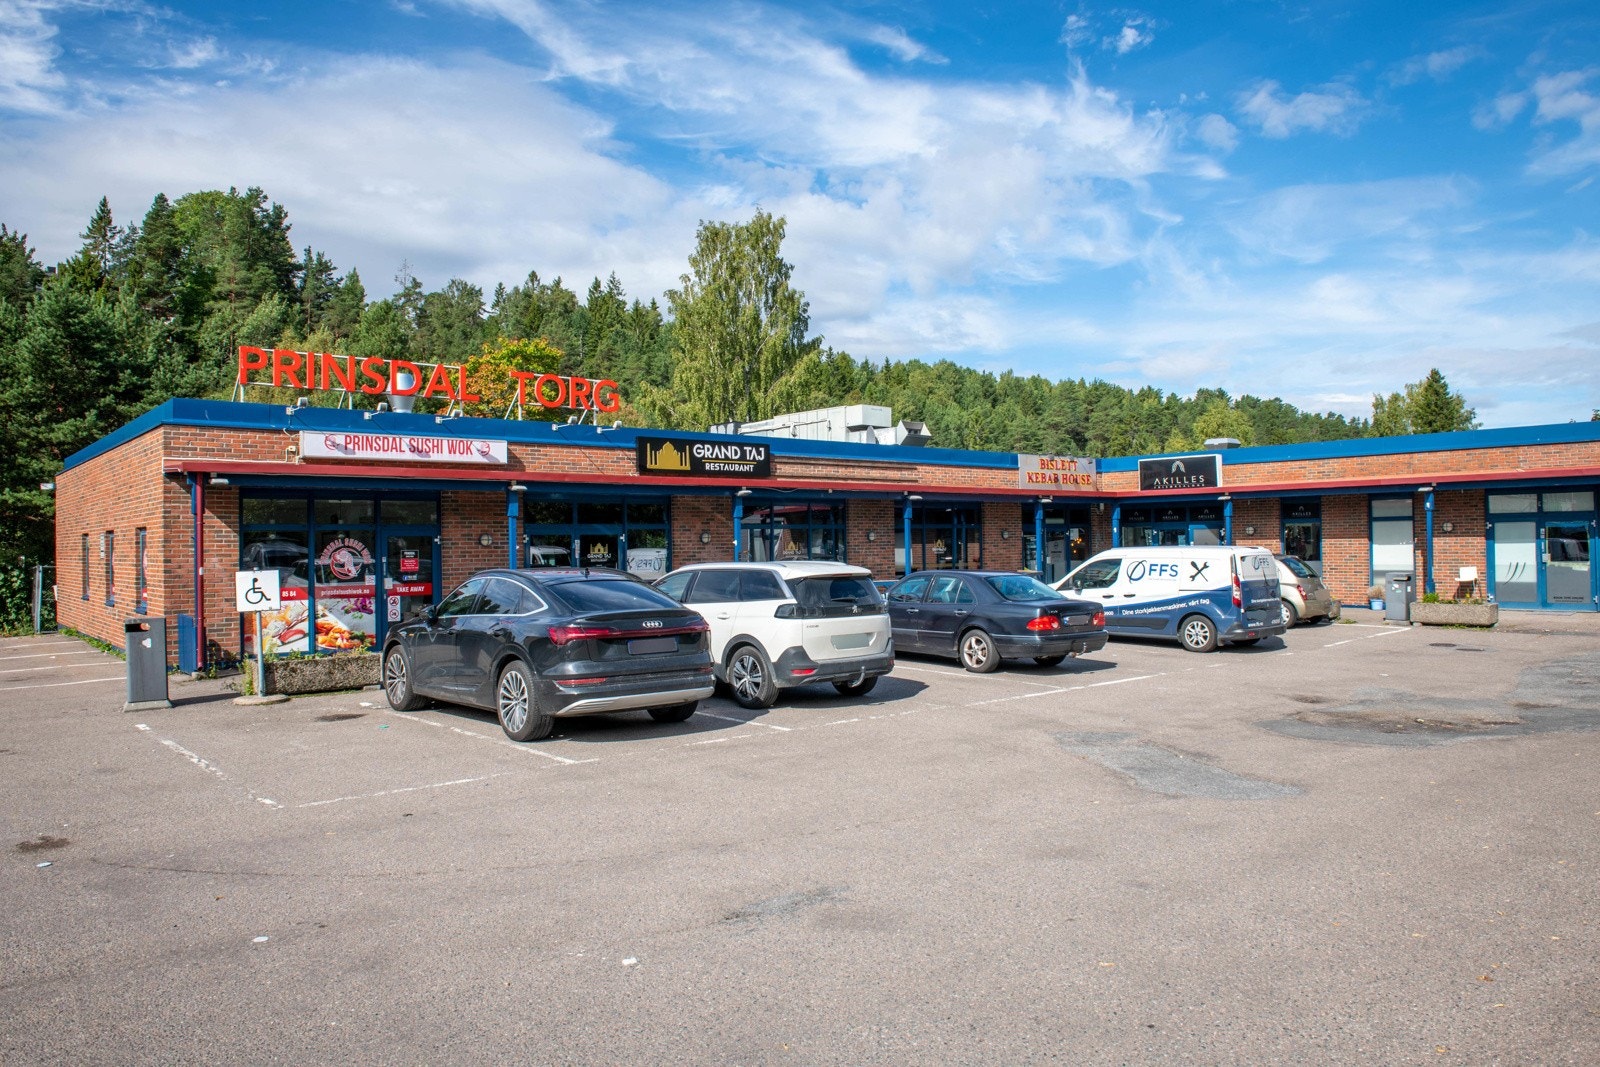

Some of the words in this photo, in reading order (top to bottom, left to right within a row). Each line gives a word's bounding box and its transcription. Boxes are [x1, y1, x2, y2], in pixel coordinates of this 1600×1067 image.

[238, 345, 480, 401] PRINSDAL
[510, 371, 620, 413] TORG
[344, 434, 406, 453] PRINSDAL
[408, 438, 445, 455] SUSHI
[447, 440, 473, 456] WOK
[693, 444, 740, 460] GRAND
[743, 446, 765, 461] TAJ
[705, 463, 754, 472] RESTAURANT
[1039, 458, 1078, 471] BISLETT
[1026, 472, 1059, 484] KEBAB
[1061, 473, 1091, 485] HOUSE
[1153, 474, 1205, 485] AKILLES
